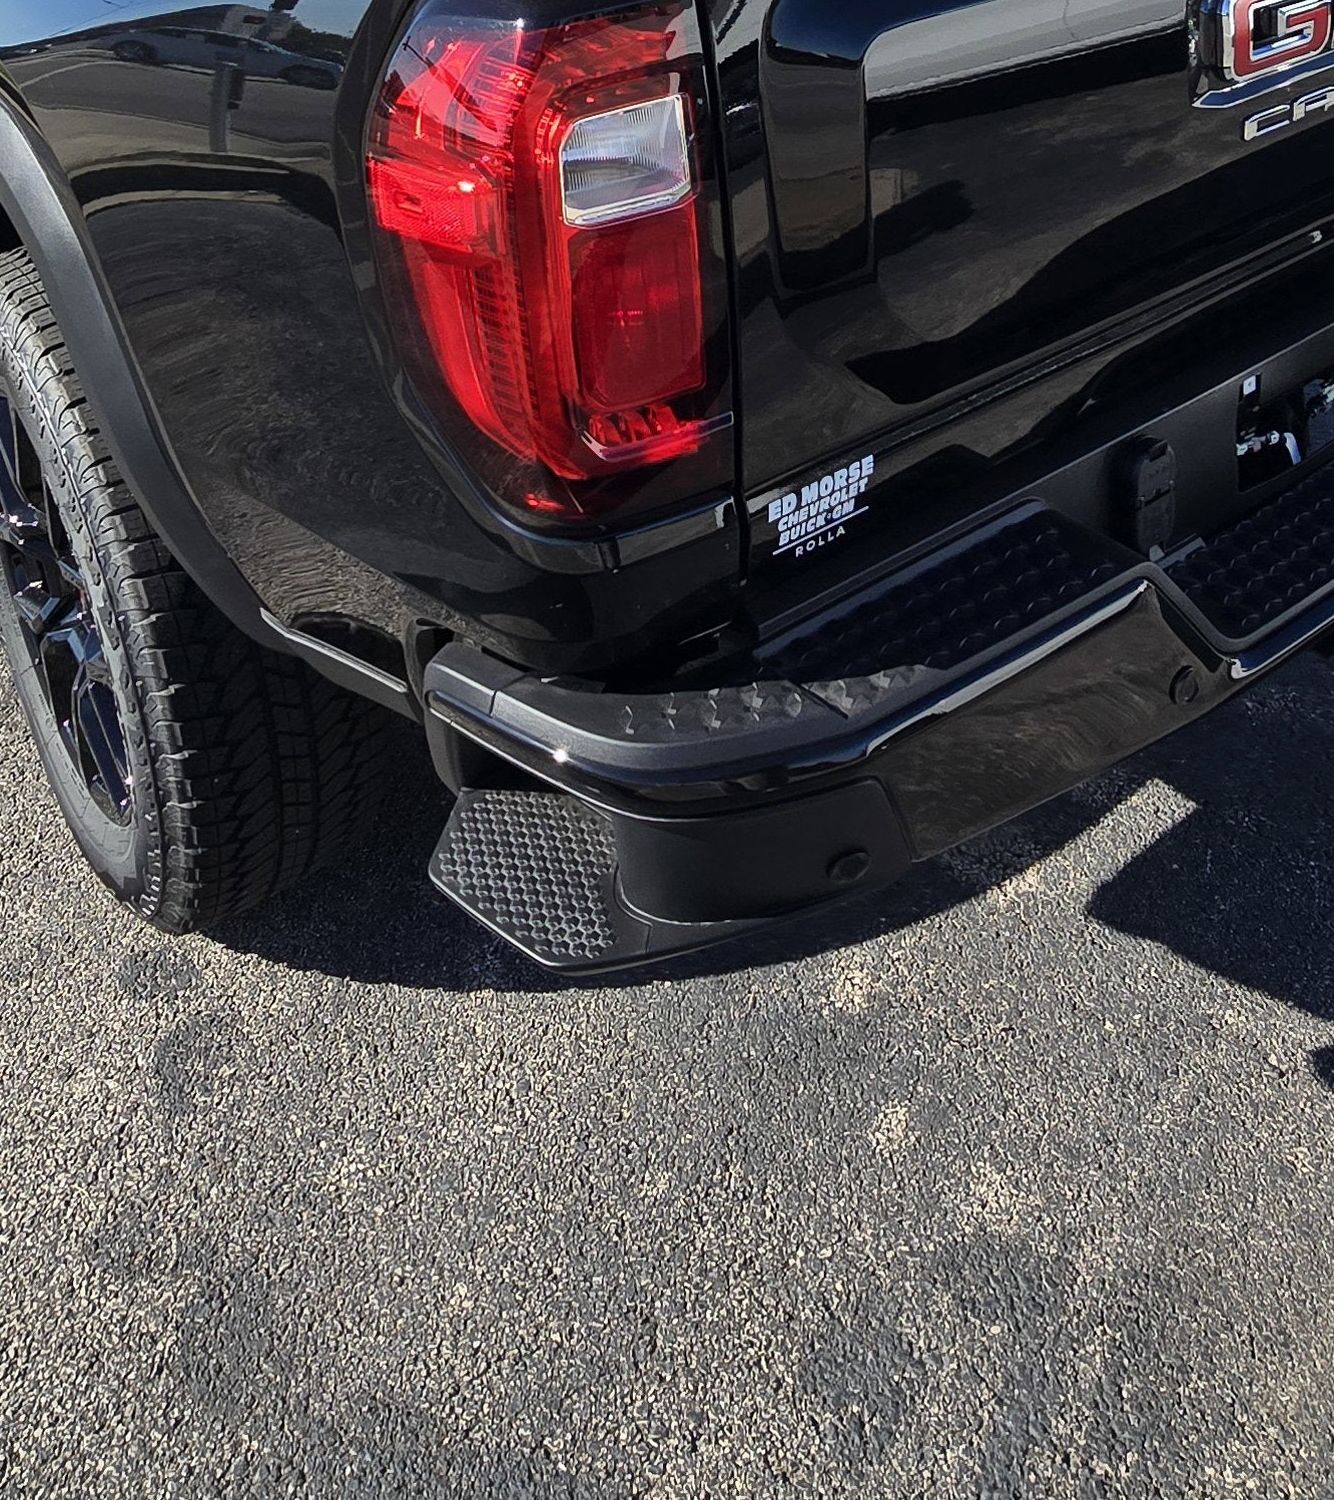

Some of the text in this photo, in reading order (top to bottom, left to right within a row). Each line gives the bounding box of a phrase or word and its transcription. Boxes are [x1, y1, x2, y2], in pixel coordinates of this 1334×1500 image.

[768, 454, 875, 523] ED MORSE
[778, 477, 869, 532] CHEVROLET
[795, 525, 846, 557] ROLLA
